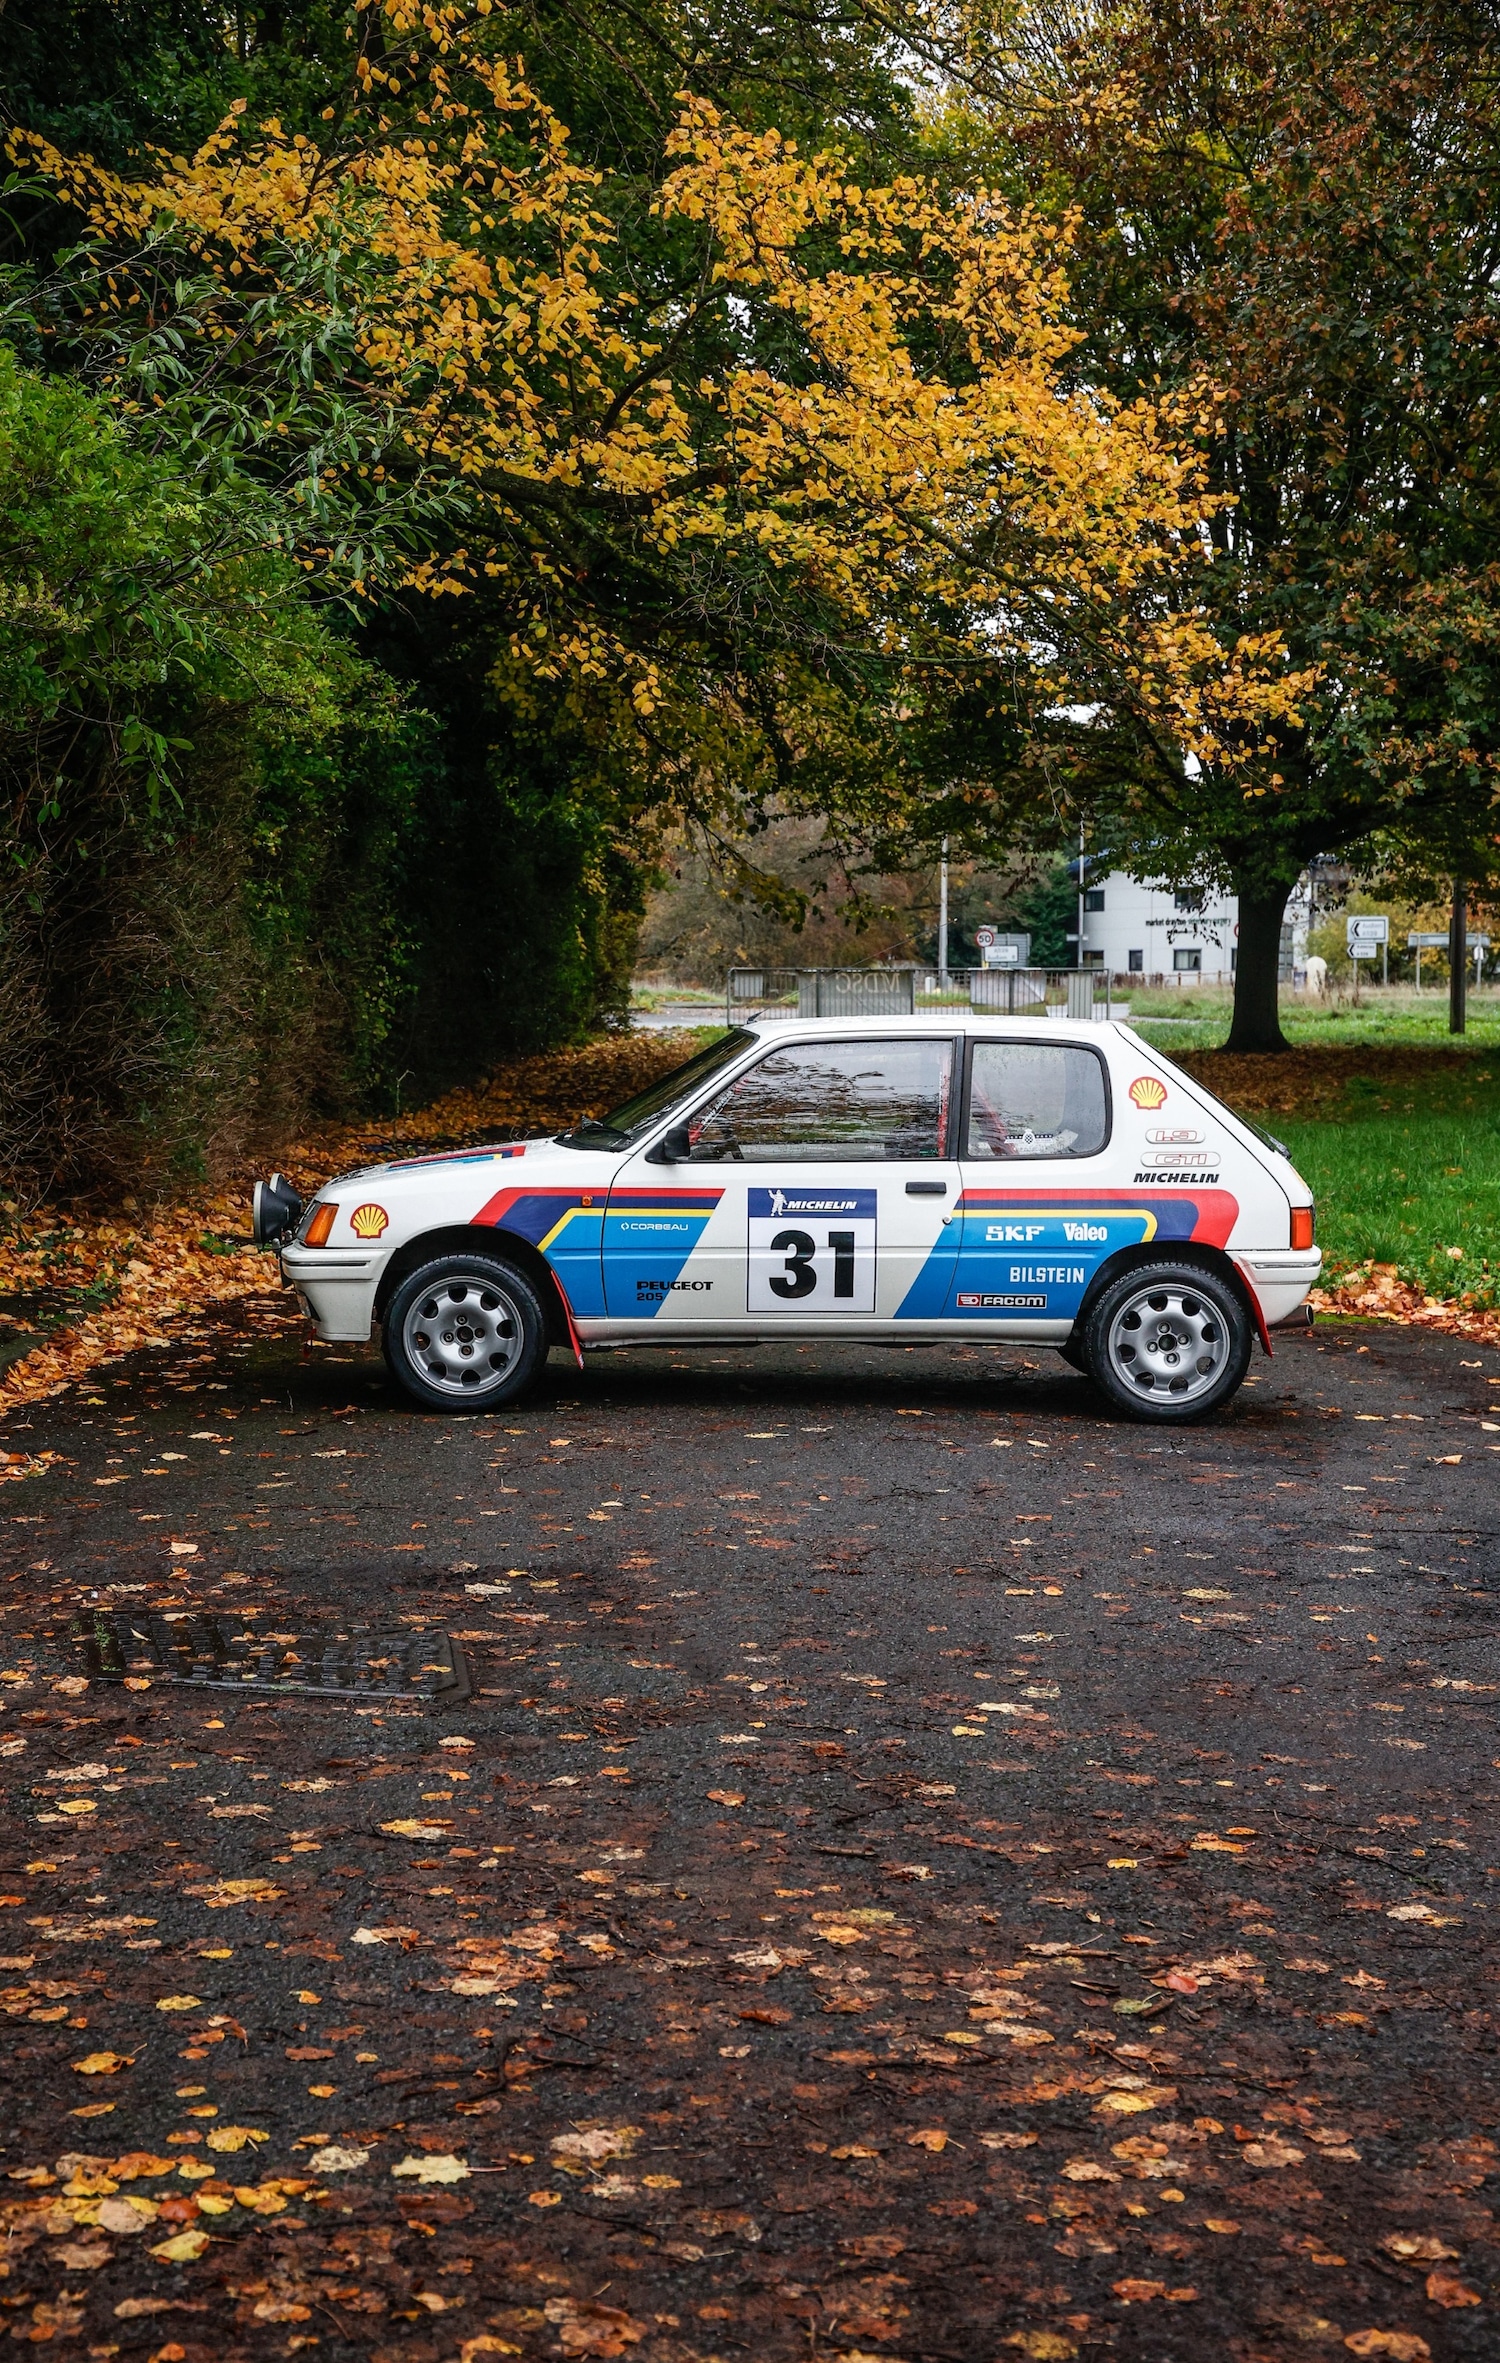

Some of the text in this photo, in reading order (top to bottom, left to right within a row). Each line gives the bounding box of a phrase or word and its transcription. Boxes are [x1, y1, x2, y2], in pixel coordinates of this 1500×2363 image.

[978, 935, 991, 943] 50
[1155, 1153, 1207, 1165] GTI
[1133, 1173, 1220, 1183] MICHELIN
[786, 1200, 858, 1210] MICHELIN
[630, 1222, 689, 1231] CORBEAU
[1062, 1222, 1108, 1241] Valeo
[985, 1225, 1045, 1241] SKF
[769, 1229, 855, 1299] 31
[1009, 1266, 1085, 1283] BILSTEIN
[636, 1280, 714, 1291] PEUGEOT
[636, 1292, 664, 1301] 205
[983, 1296, 1044, 1306] FACOM
